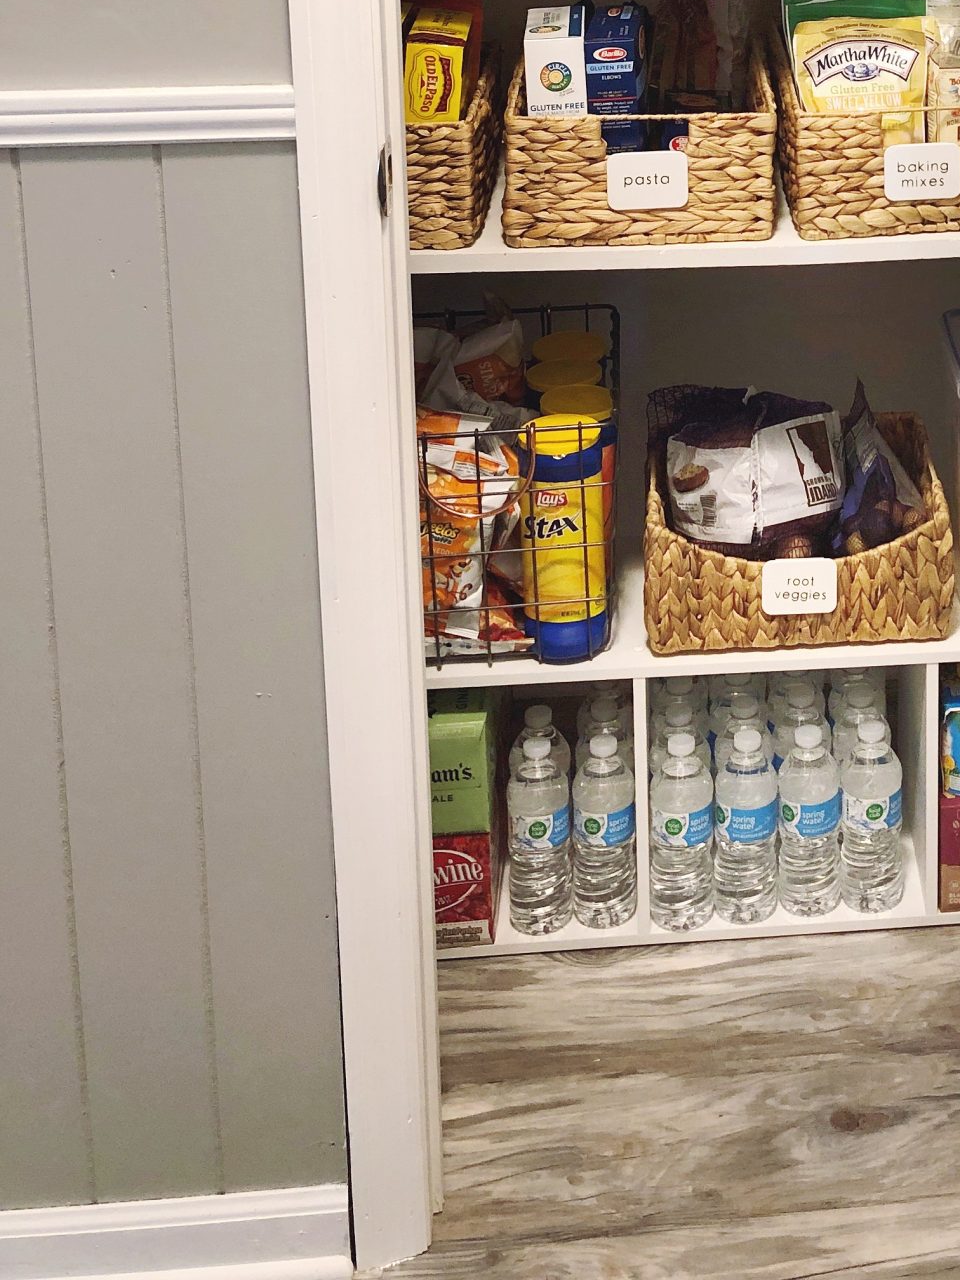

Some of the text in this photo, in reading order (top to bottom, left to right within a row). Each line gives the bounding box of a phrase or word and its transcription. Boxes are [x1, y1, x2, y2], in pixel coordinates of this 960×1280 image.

[600, 50, 624, 58] Barilla
[424, 55, 437, 76] OLD
[816, 45, 908, 78] Martha White
[830, 83, 895, 95] Gluten Free
[530, 103, 563, 112] GLUTEN
[565, 101, 585, 110] FREE
[826, 93, 900, 110] SWEET YELLOW
[897, 160, 949, 174] baking
[623, 172, 670, 188] pasta
[901, 176, 945, 188] mixes
[537, 491, 566, 505] Lay's
[808, 483, 837, 502] IDAHO
[787, 574, 815, 587] root
[774, 588, 827, 603] veggies
[432, 793, 454, 803] ALE
[690, 814, 710, 826] spring
[732, 815, 756, 825] spring
[802, 810, 825, 821] spring
[802, 817, 824, 825] water
[690, 821, 709, 832] water
[732, 822, 755, 830] water
[434, 859, 484, 884] wine
